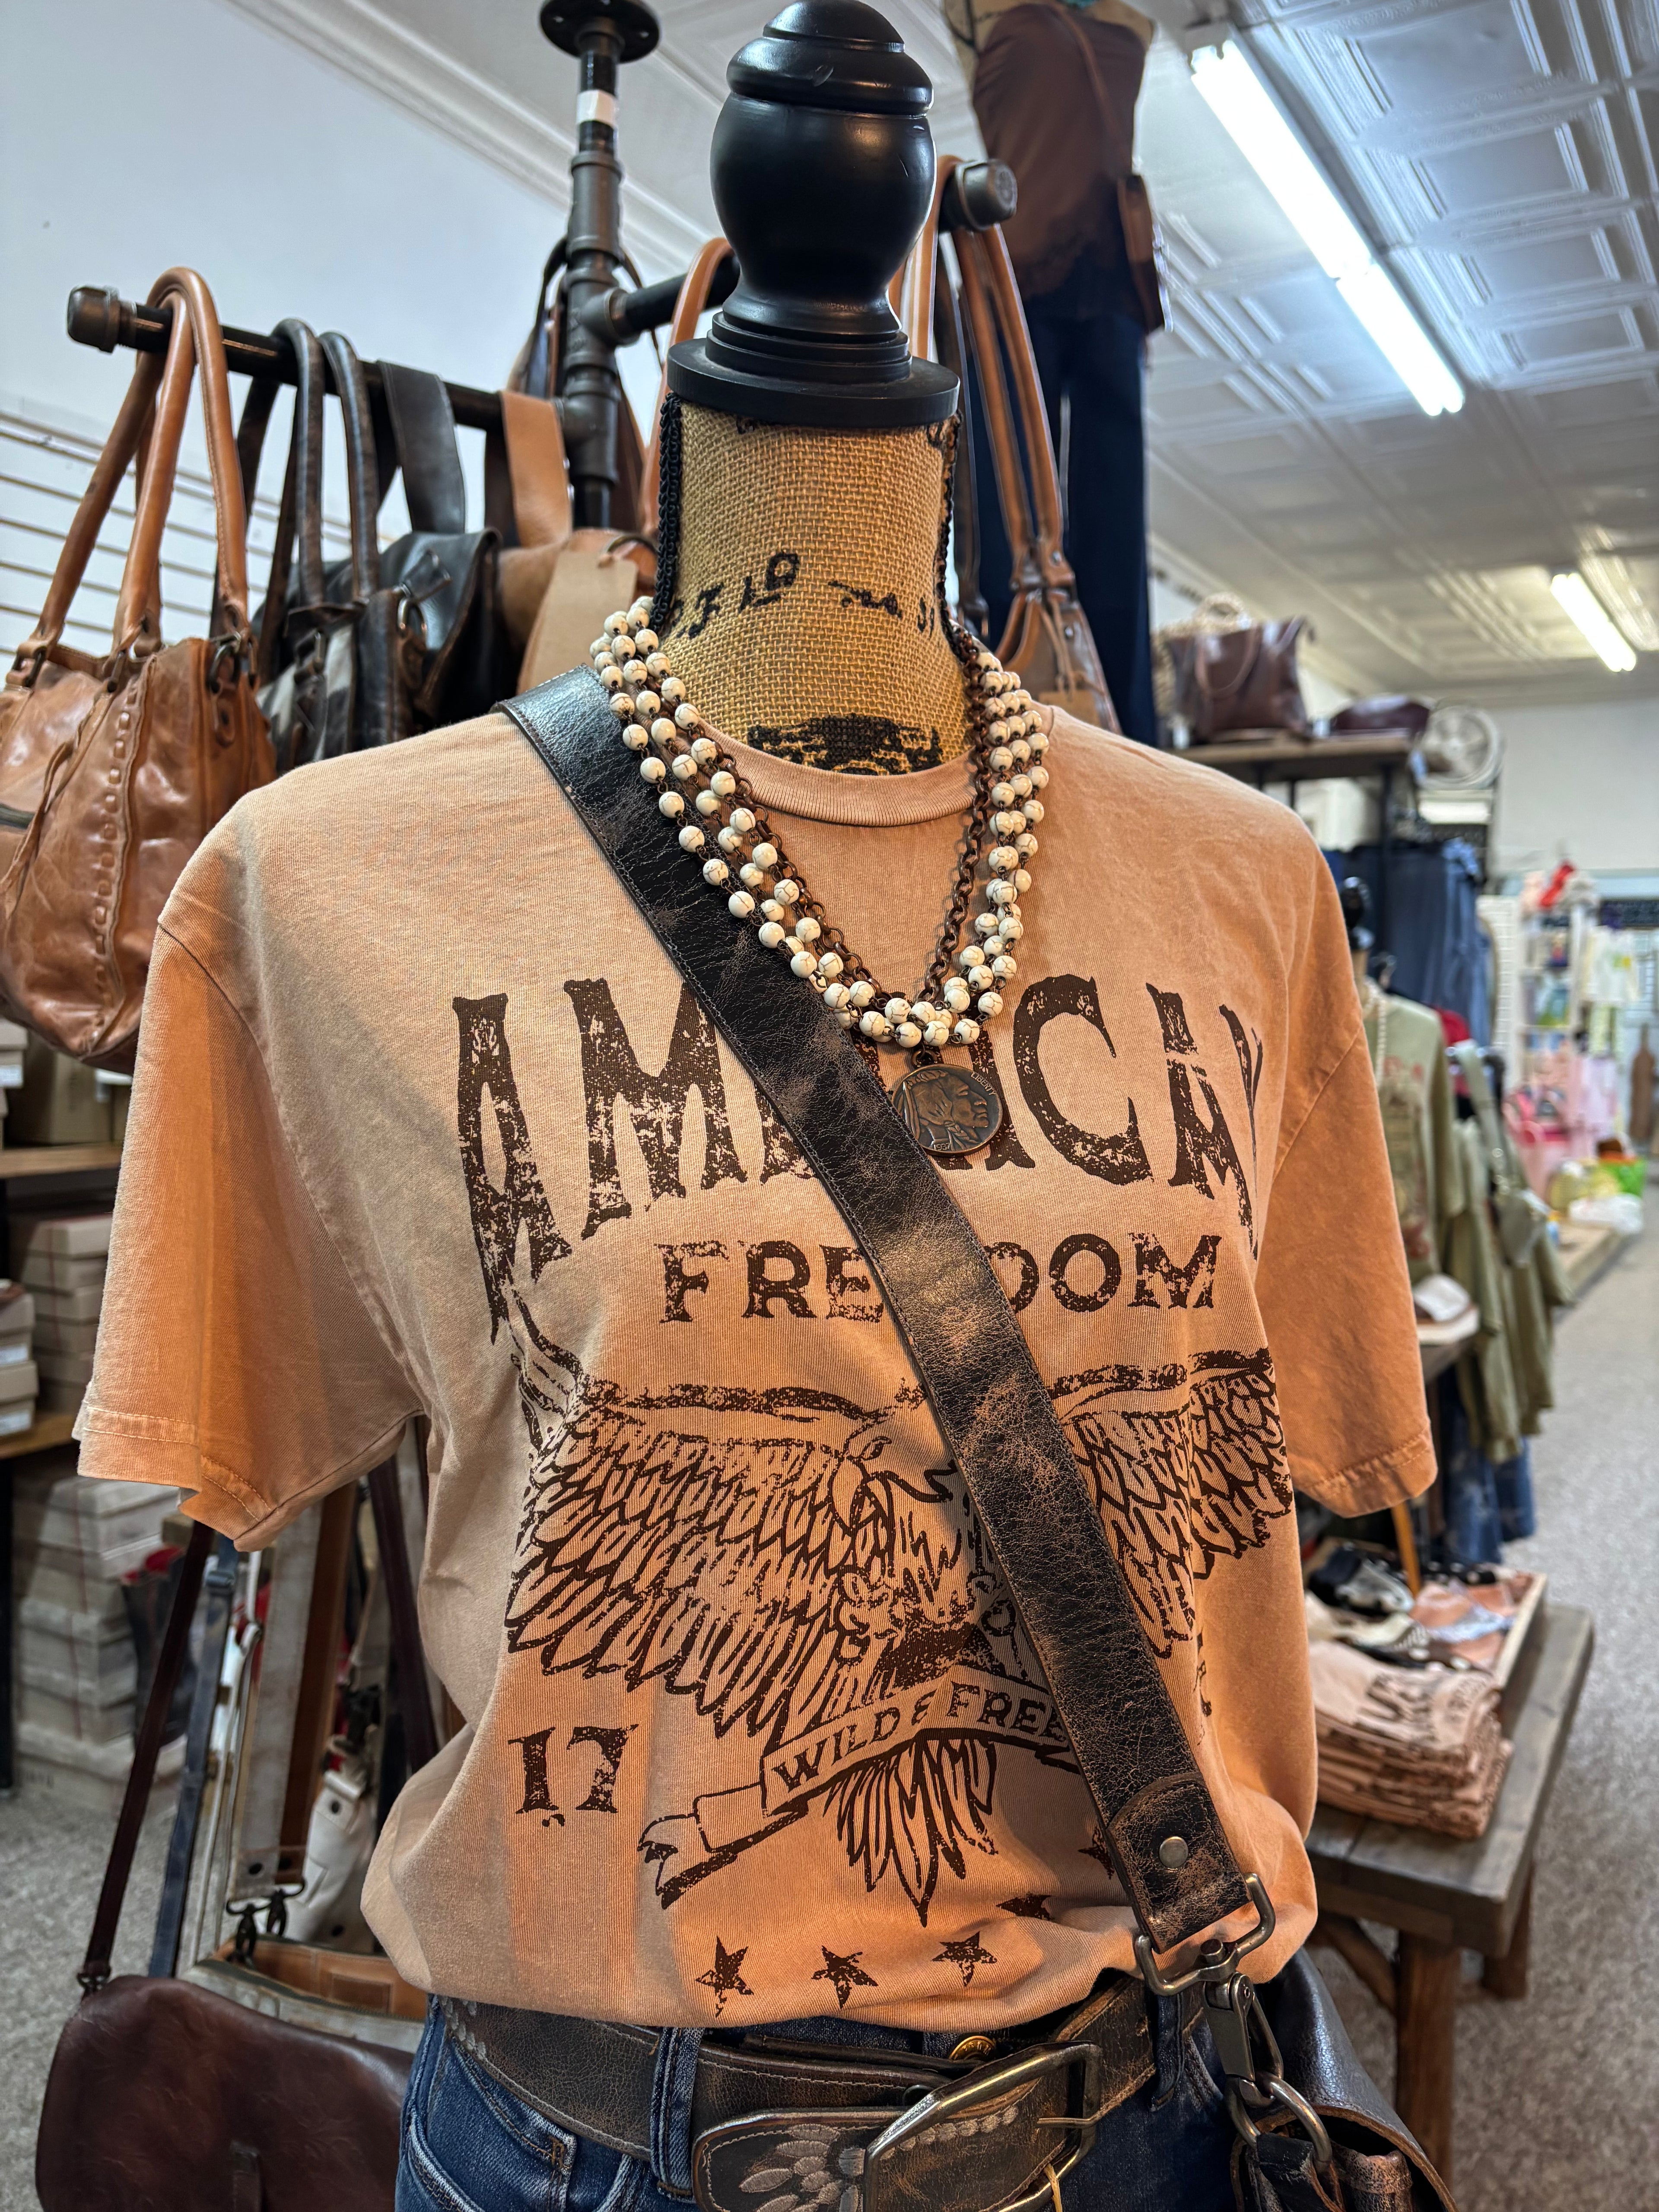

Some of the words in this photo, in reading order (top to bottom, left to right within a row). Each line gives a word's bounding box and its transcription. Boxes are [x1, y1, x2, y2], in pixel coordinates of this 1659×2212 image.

[970, 1071, 997, 1096] LIBERTY
[452, 973, 1263, 1345] AMICA
[933, 1142, 950, 1150] 1937
[654, 1232, 1222, 1323] FREDOM
[772, 1707, 901, 1792] WILD
